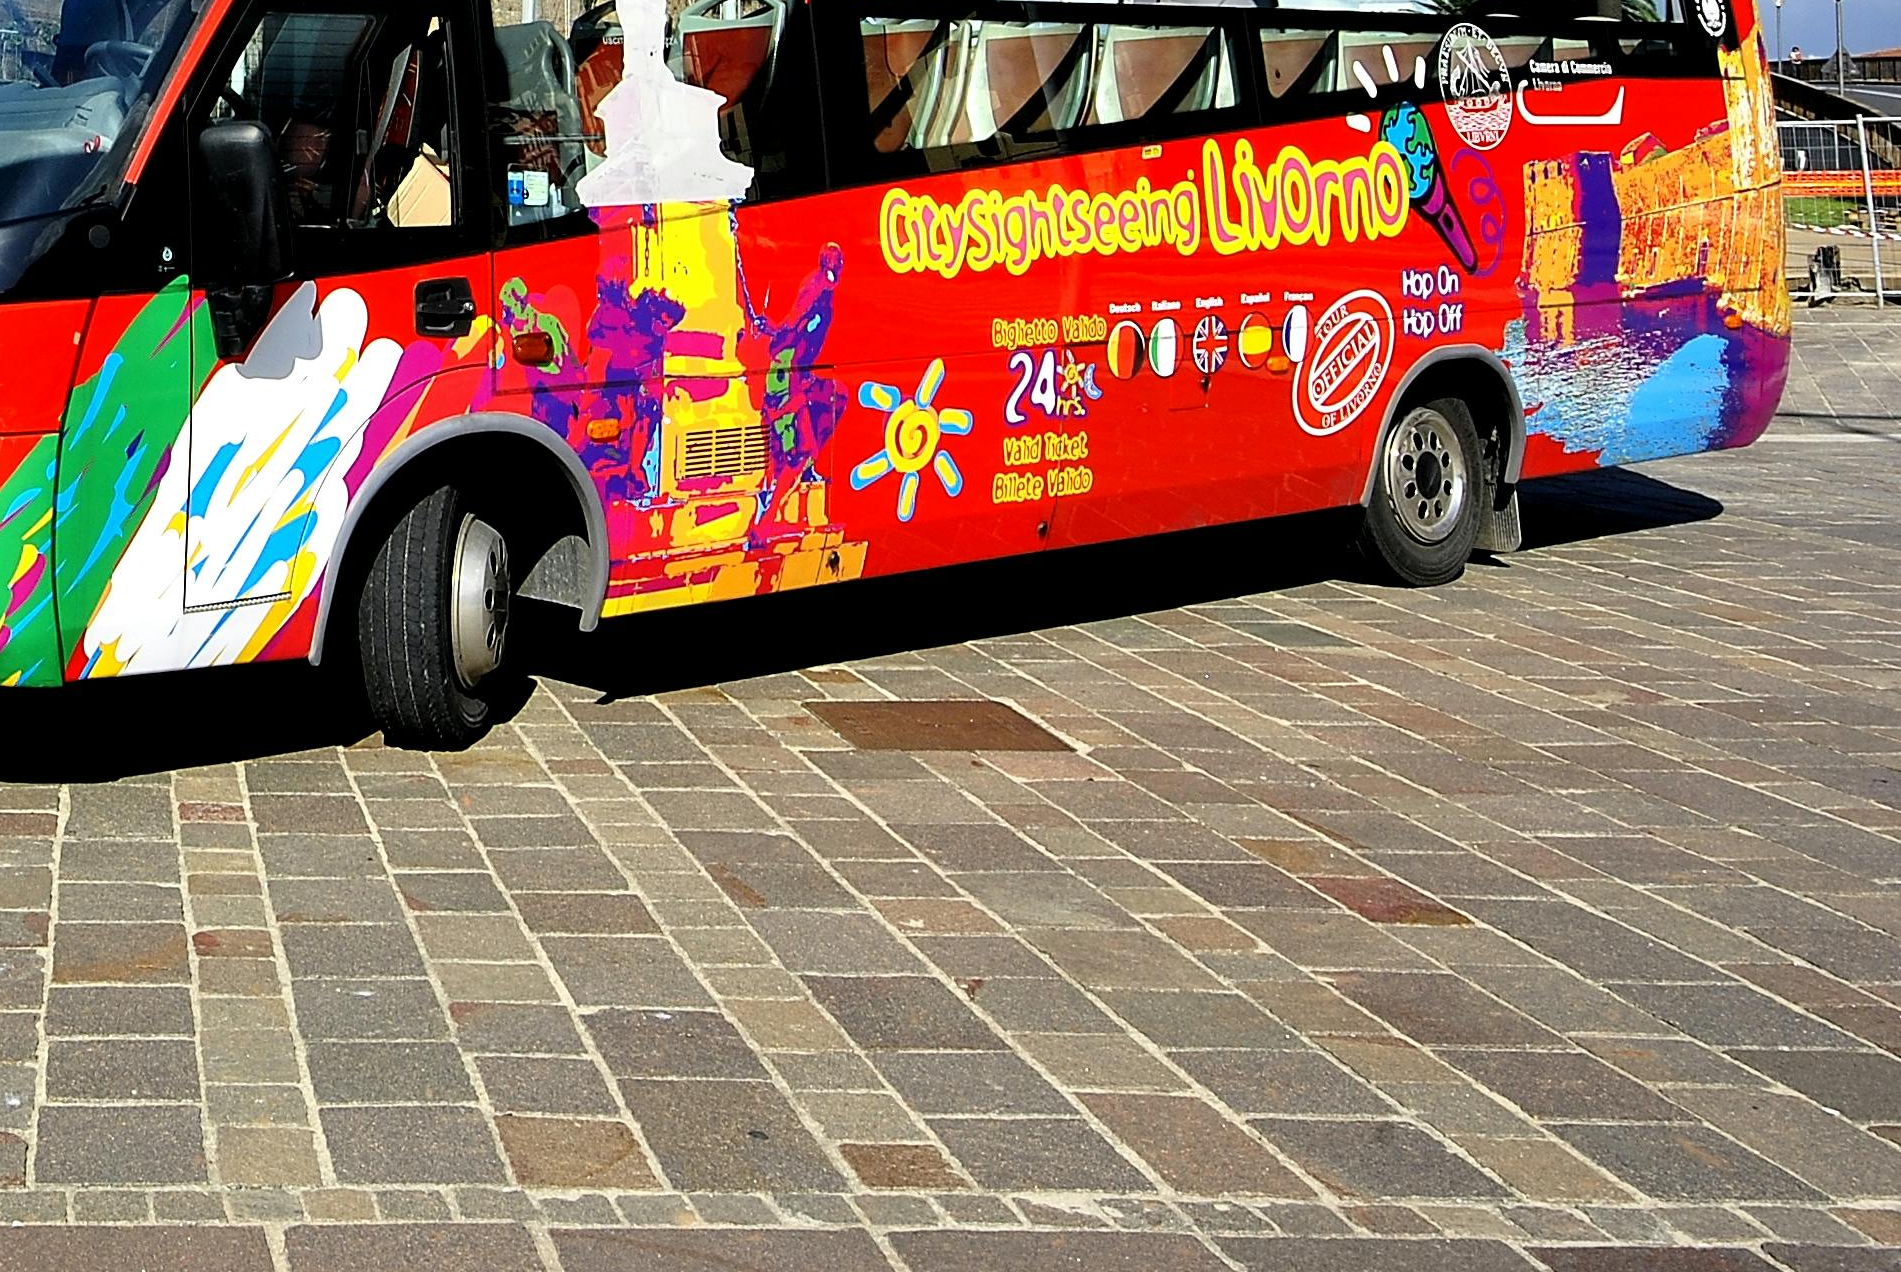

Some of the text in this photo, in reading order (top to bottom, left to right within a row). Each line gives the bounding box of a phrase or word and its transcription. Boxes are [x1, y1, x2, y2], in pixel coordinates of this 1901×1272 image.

[1402, 265, 1459, 300] Hop On
[992, 314, 1107, 351] Biglietto Valido
[1315, 304, 1349, 343] TOUR
[1403, 303, 1464, 339] Hop Off
[1312, 320, 1377, 400] OFFICIAL
[1005, 349, 1086, 425] 24 hrs.
[1321, 362, 1382, 428] OF LIVORNO
[1003, 431, 1088, 466] Valid Ticket
[992, 466, 1094, 504] Billete Valido
